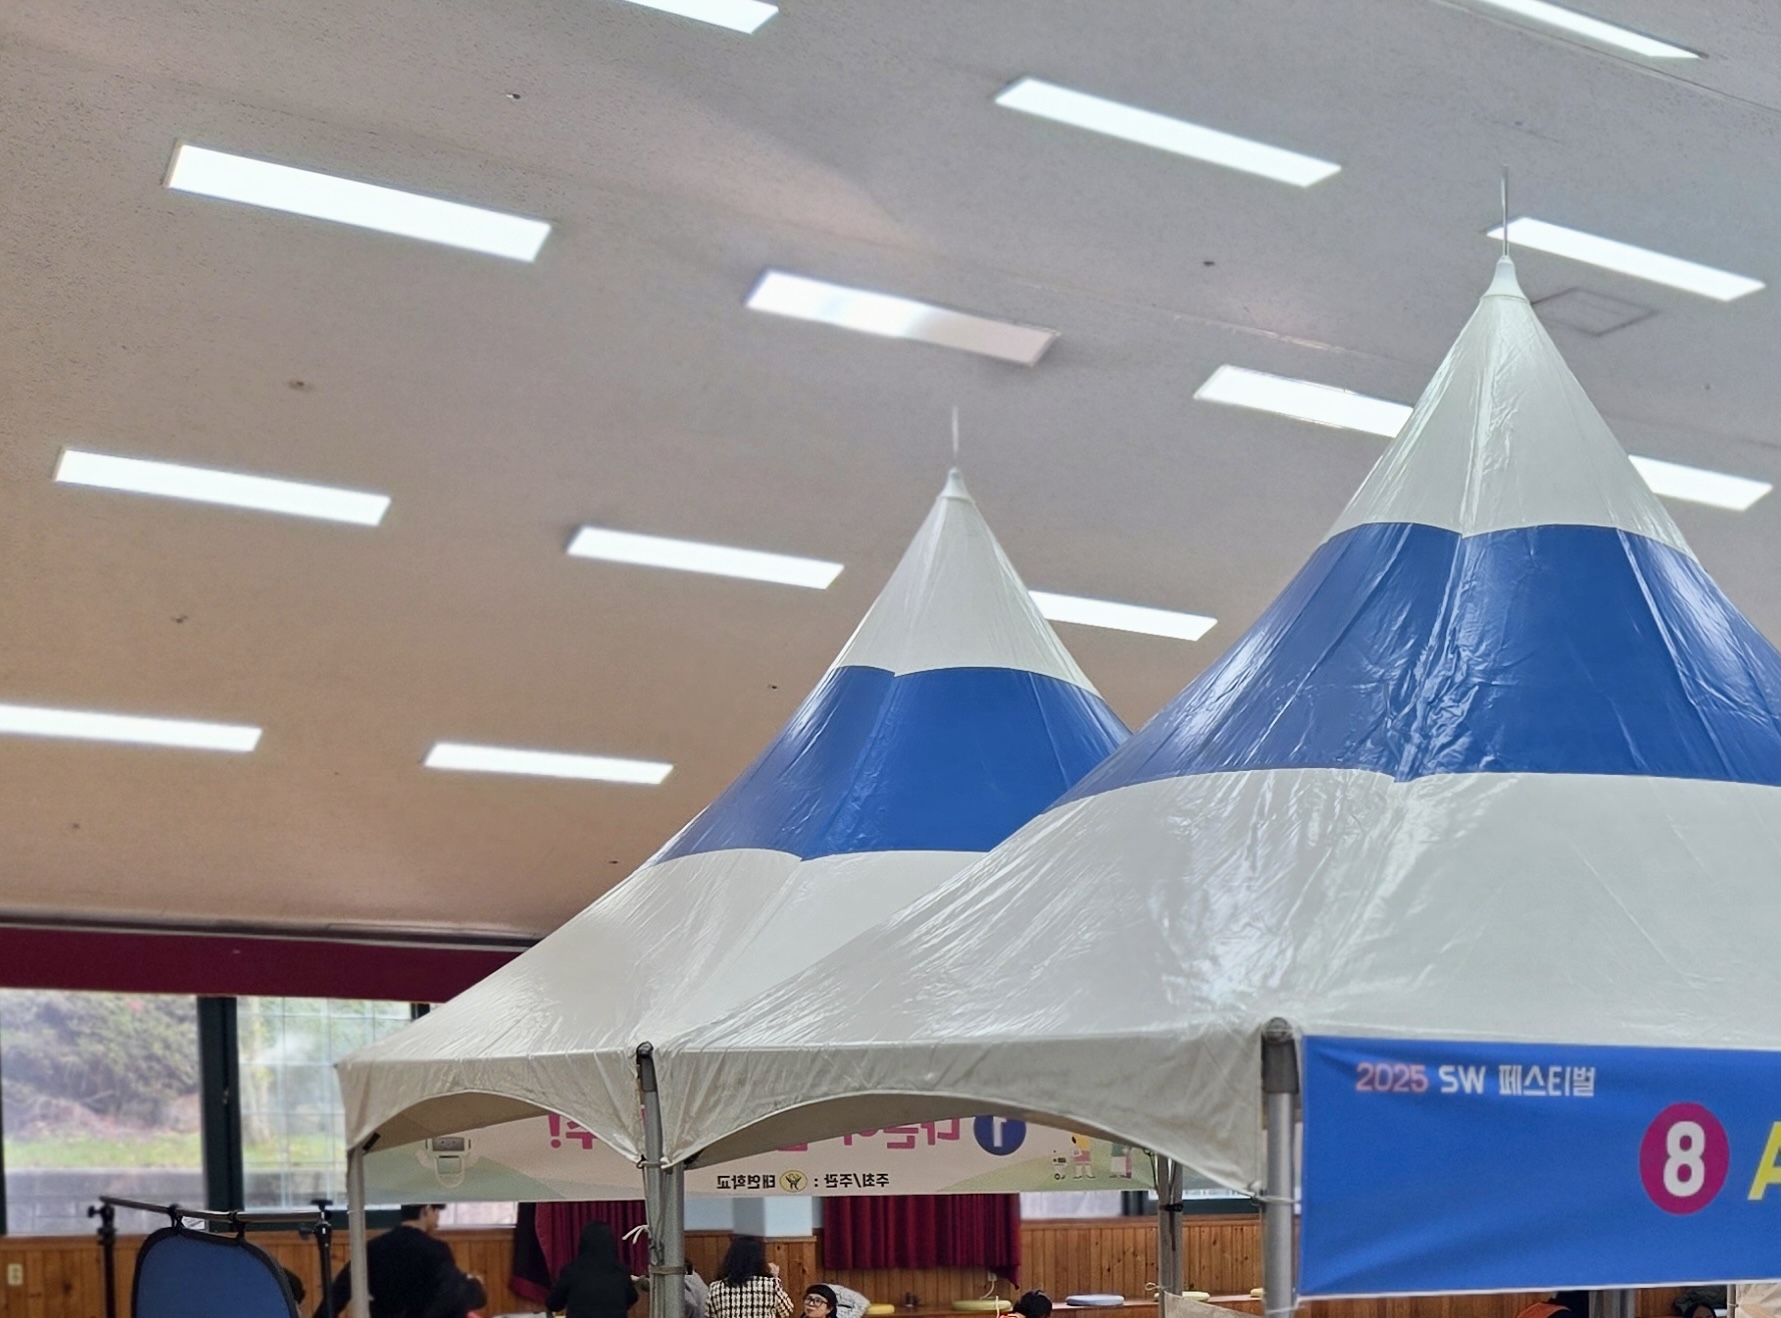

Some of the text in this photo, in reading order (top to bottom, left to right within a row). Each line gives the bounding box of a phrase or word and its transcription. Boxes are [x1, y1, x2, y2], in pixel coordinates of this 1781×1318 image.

[1355, 1062, 1596, 1097] 2025 SW 페스티벌
[1663, 1120, 1706, 1198] 8
